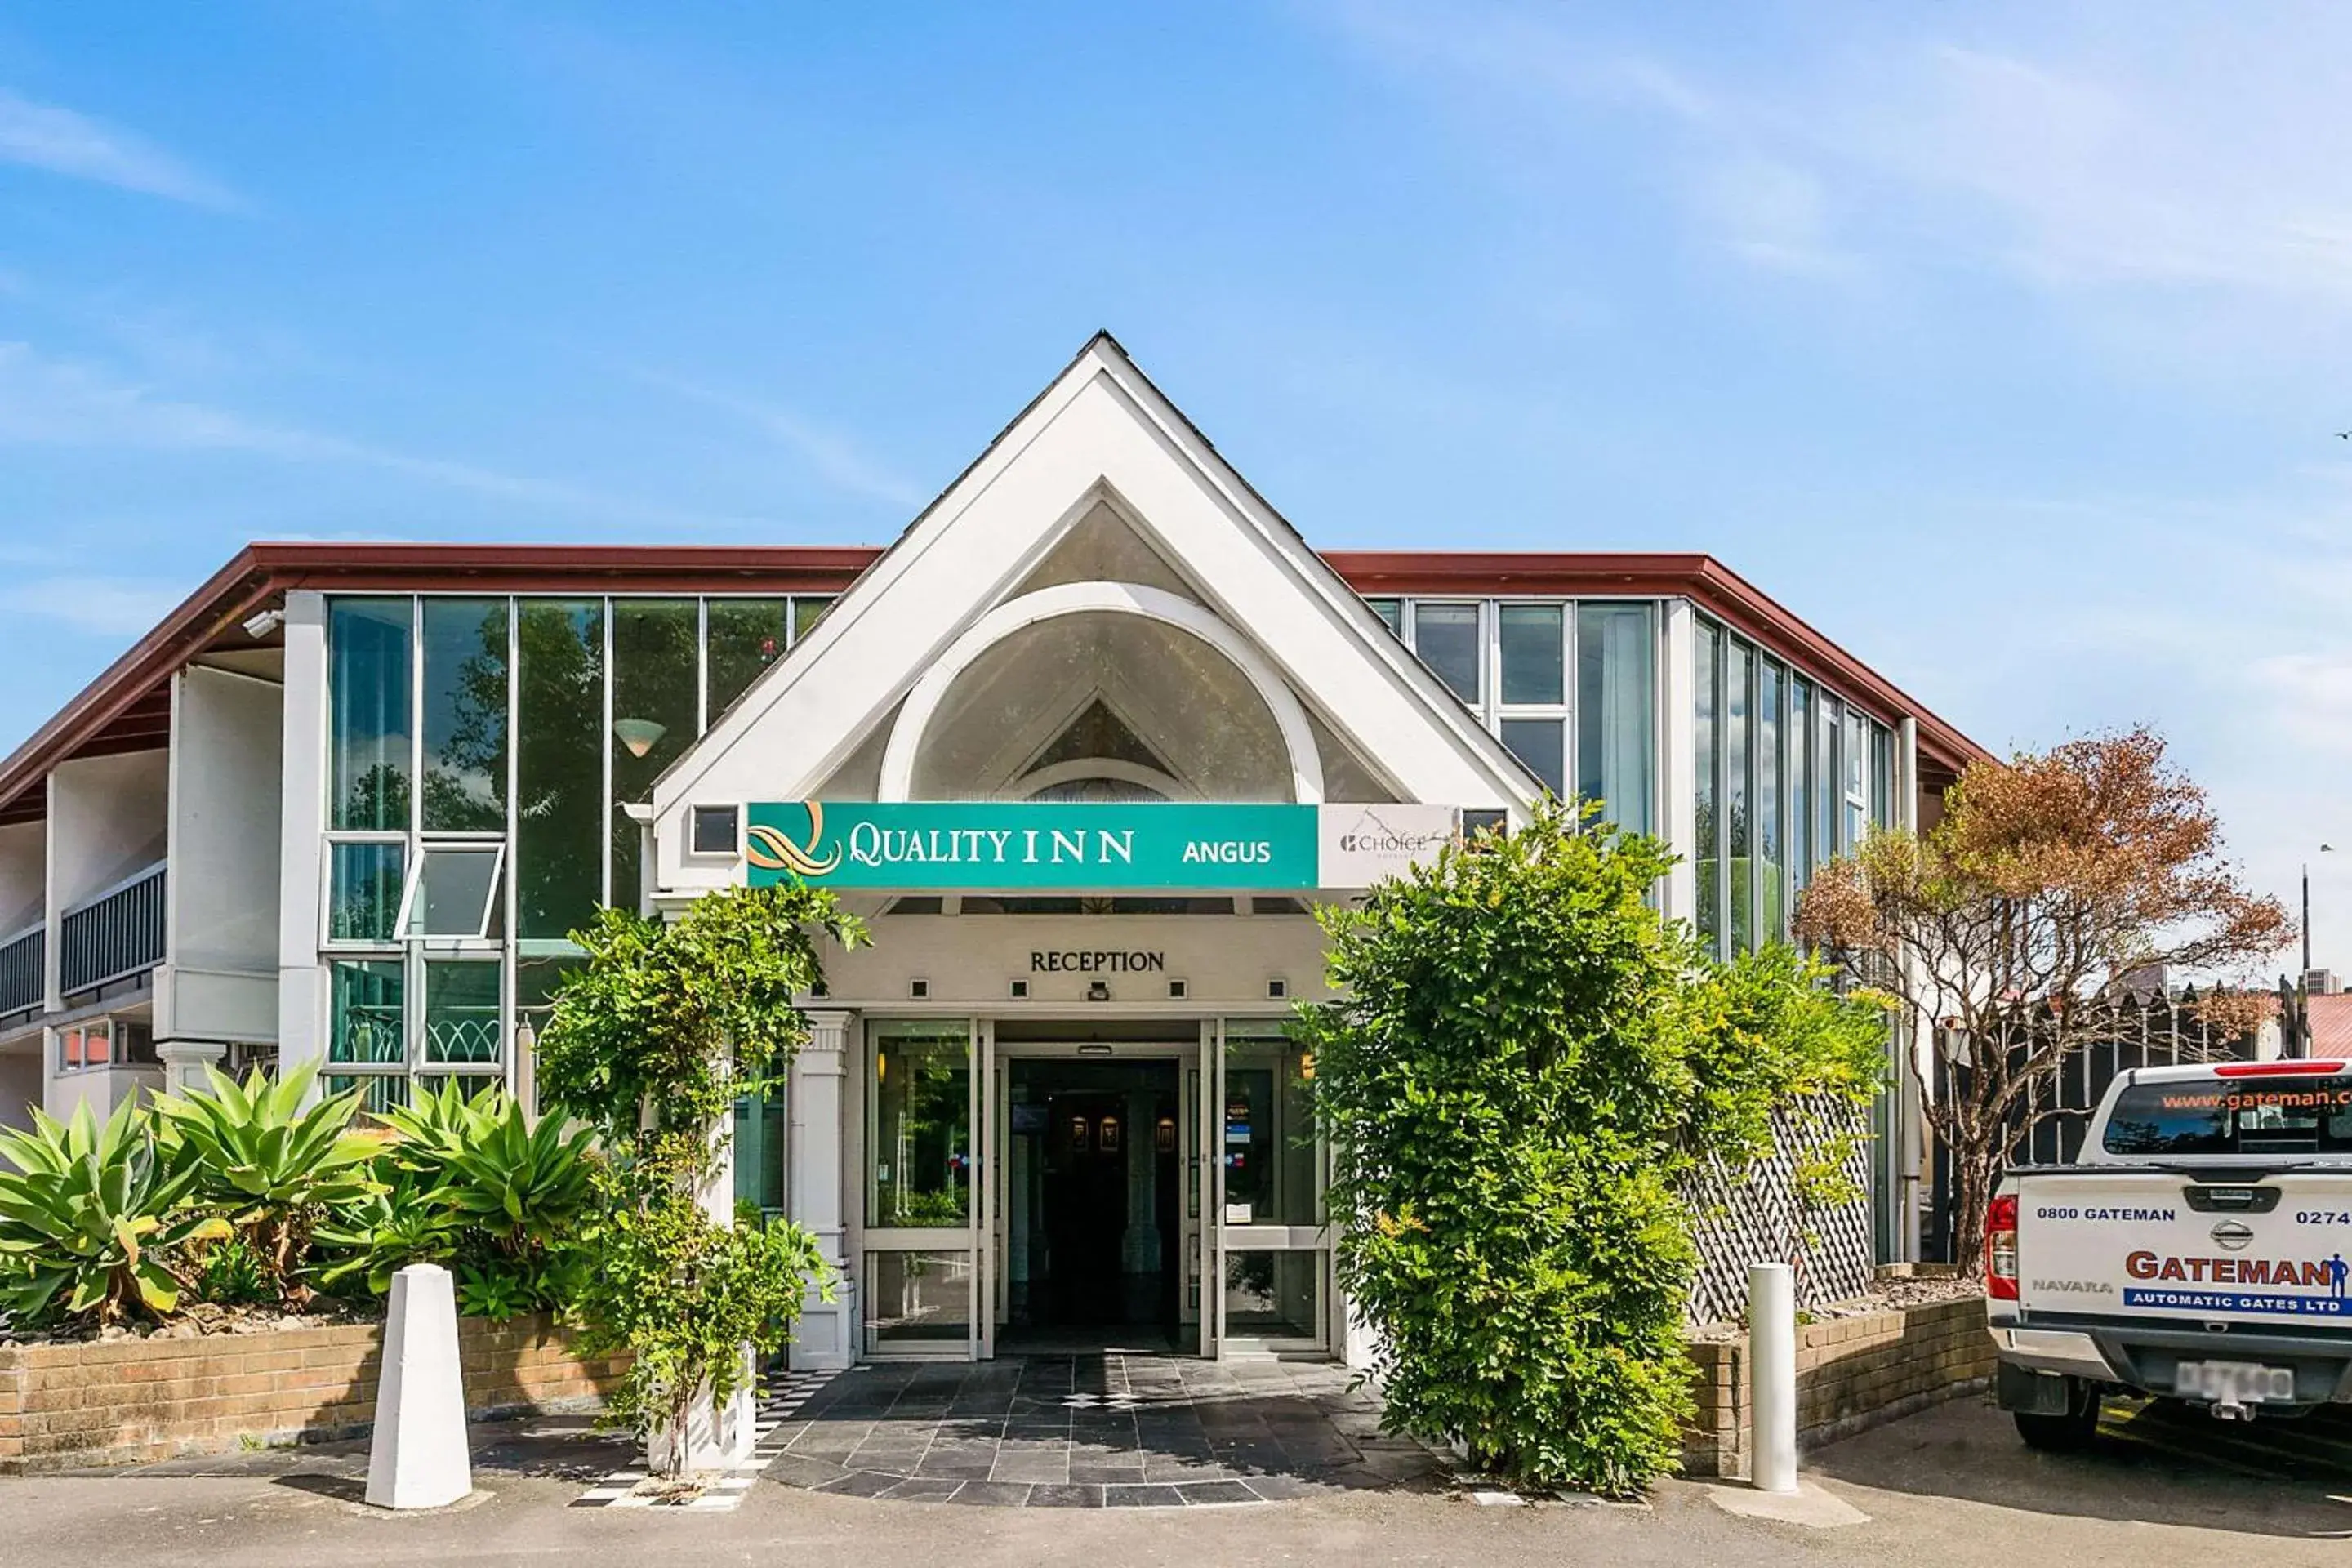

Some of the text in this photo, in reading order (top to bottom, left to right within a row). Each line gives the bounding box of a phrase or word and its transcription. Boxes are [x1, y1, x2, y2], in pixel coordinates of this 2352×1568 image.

[849, 821, 1272, 866] QUALITY INN ANGUS
[1359, 835, 1427, 851] CHOICE
[1031, 951, 1165, 972] RECEPTION
[2162, 1090, 2352, 1111] www.gateman.c
[2038, 1208, 2176, 1221] 0800 GATEMAN
[2296, 1211, 2350, 1224] 0274
[2125, 1250, 2331, 1286] GATEMAN
[2033, 1279, 2114, 1294] NAVARA
[2133, 1293, 2341, 1312] AUTOMATIC GATES LTD
